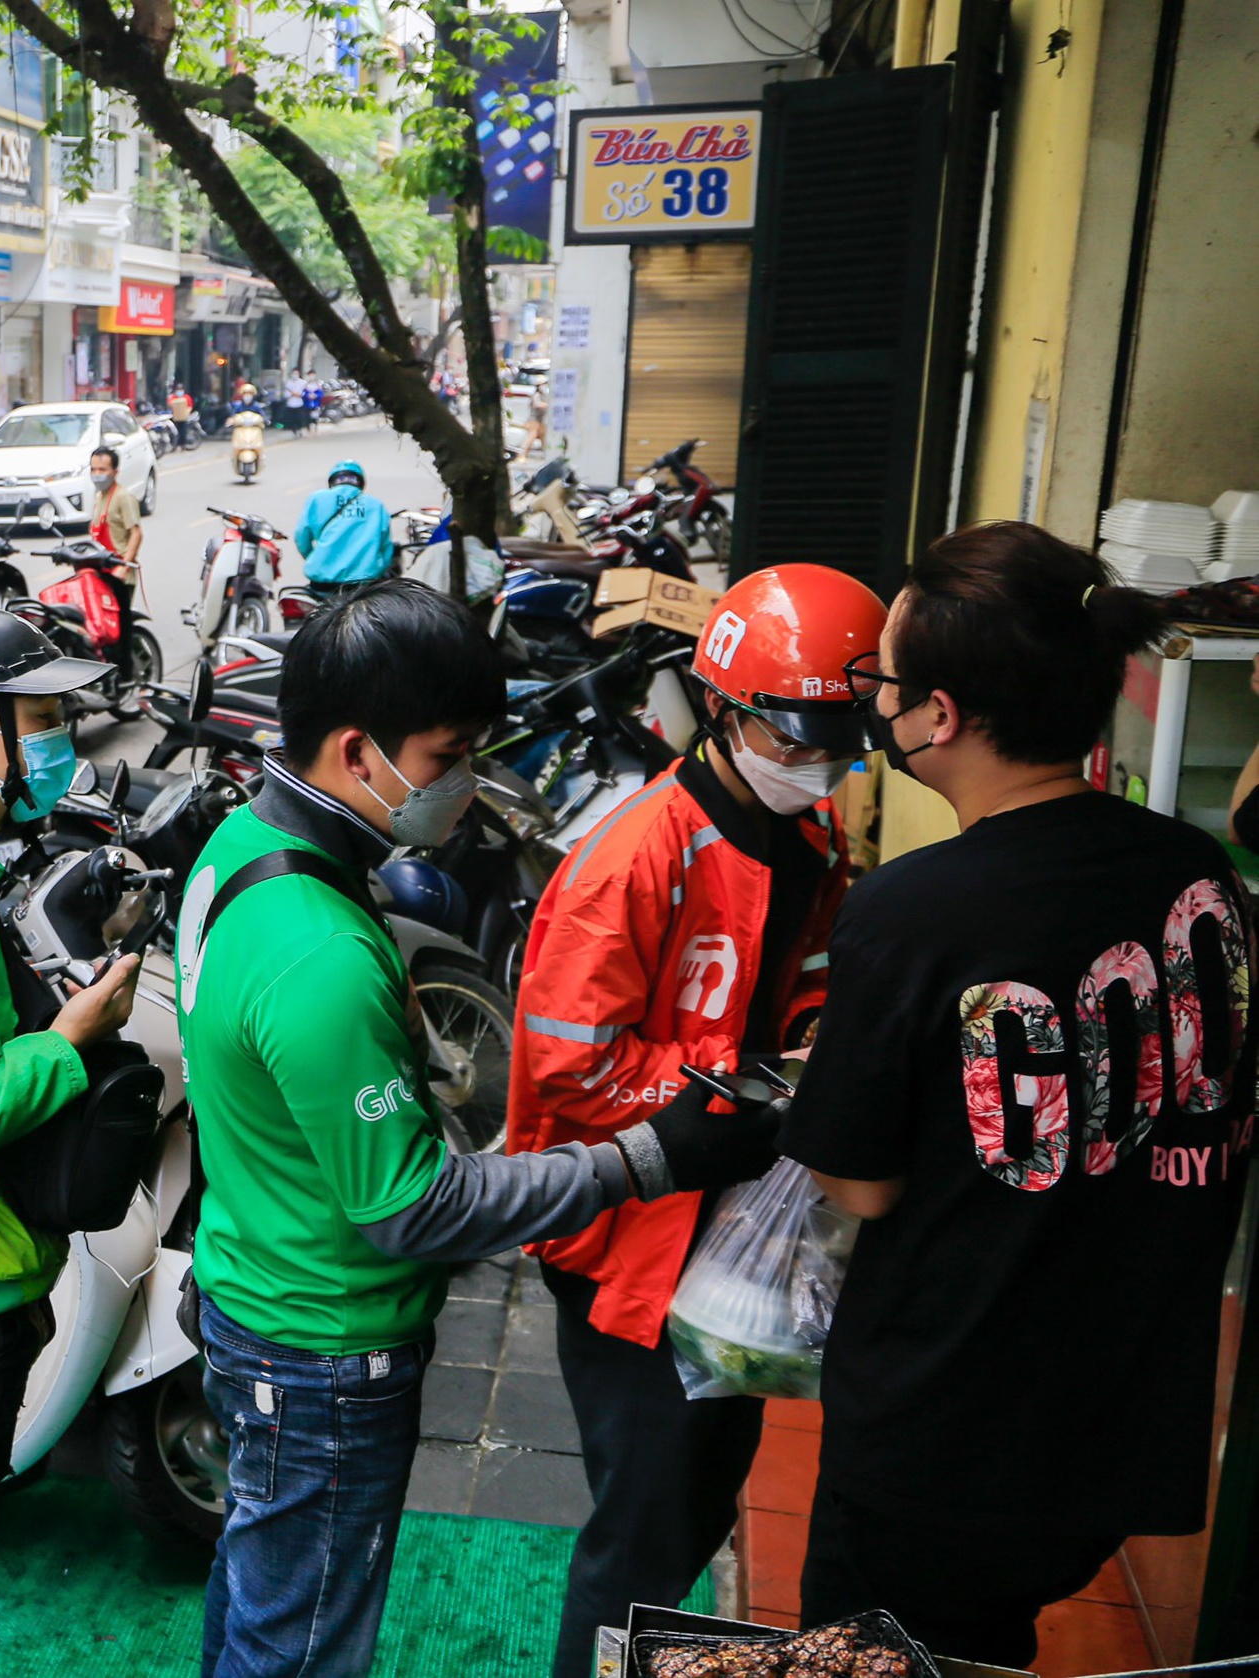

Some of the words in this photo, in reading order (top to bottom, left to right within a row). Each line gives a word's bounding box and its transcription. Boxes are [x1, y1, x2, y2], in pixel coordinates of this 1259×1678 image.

[590, 128, 675, 167] Bún
[673, 124, 753, 164] Chả
[603, 170, 656, 222] Số
[662, 167, 731, 219] 38
[1150, 1144, 1213, 1188] BOY
